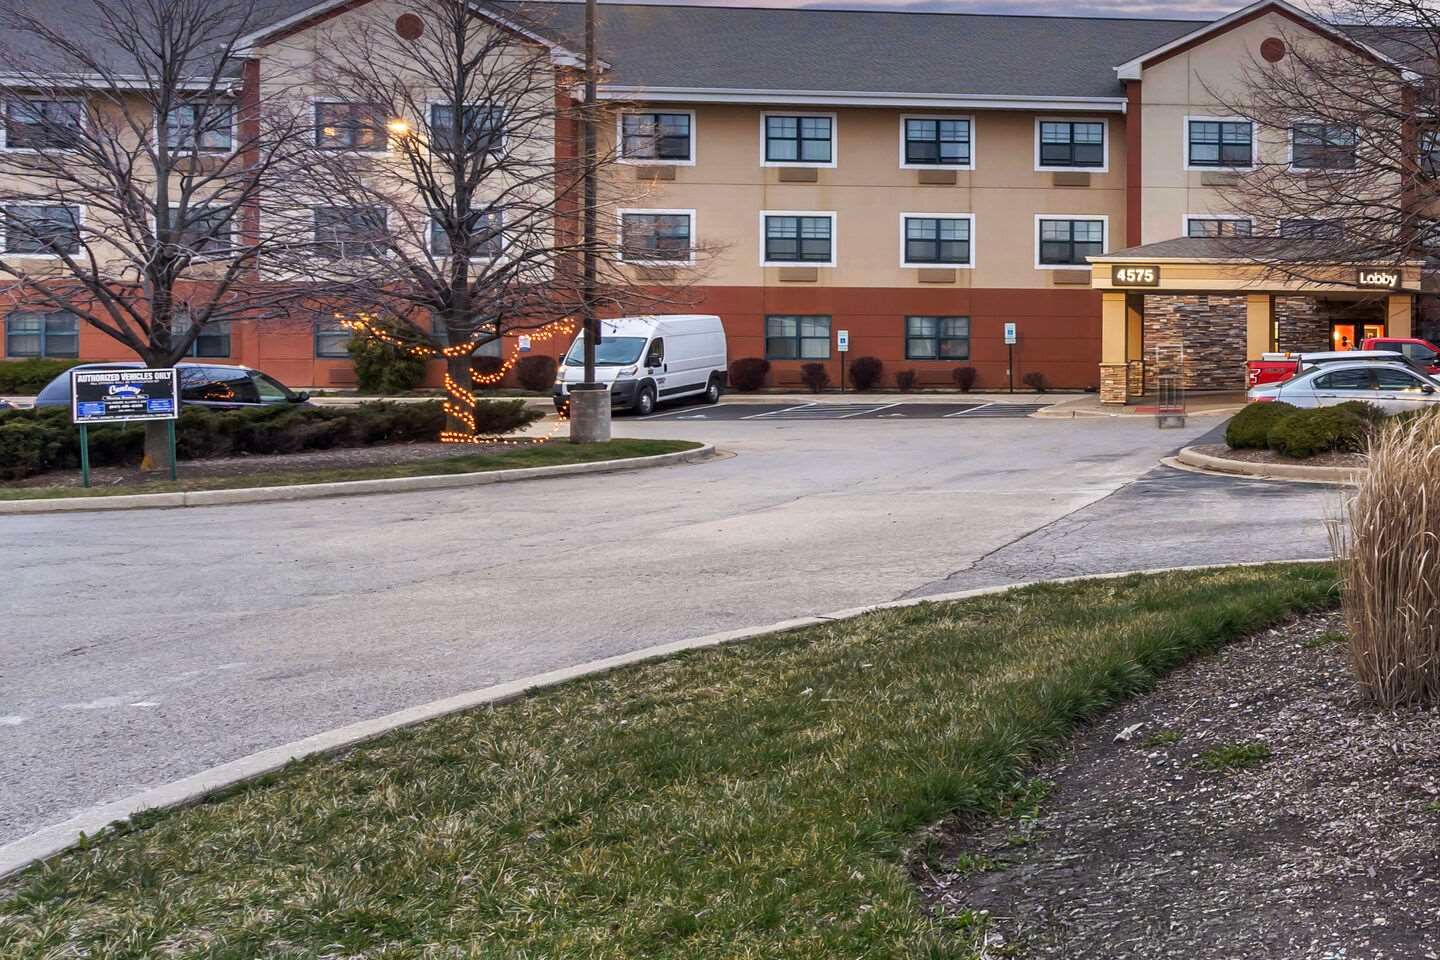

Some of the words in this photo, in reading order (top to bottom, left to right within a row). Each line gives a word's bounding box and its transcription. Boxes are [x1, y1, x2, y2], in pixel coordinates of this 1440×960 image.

[1117, 269, 1154, 282] 4575
[1360, 272, 1397, 287] Lobby
[77, 373, 120, 383] AUTHORIZED
[121, 372, 153, 381] VEHICLES
[154, 371, 172, 380] ONLY
